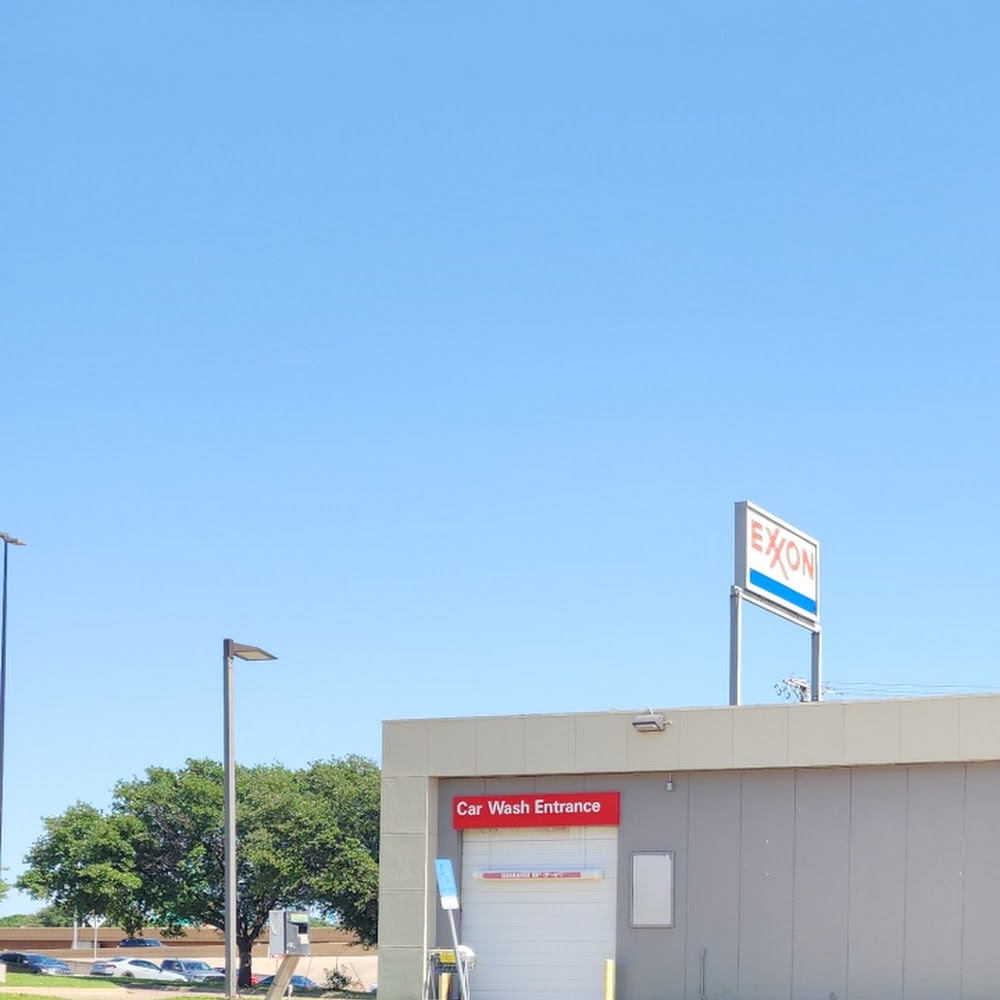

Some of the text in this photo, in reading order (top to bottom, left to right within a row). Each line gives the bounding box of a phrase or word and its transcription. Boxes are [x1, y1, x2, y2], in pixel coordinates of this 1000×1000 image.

[751, 519, 814, 581] EXXON
[456, 799, 601, 816] Car Wash Entrance
